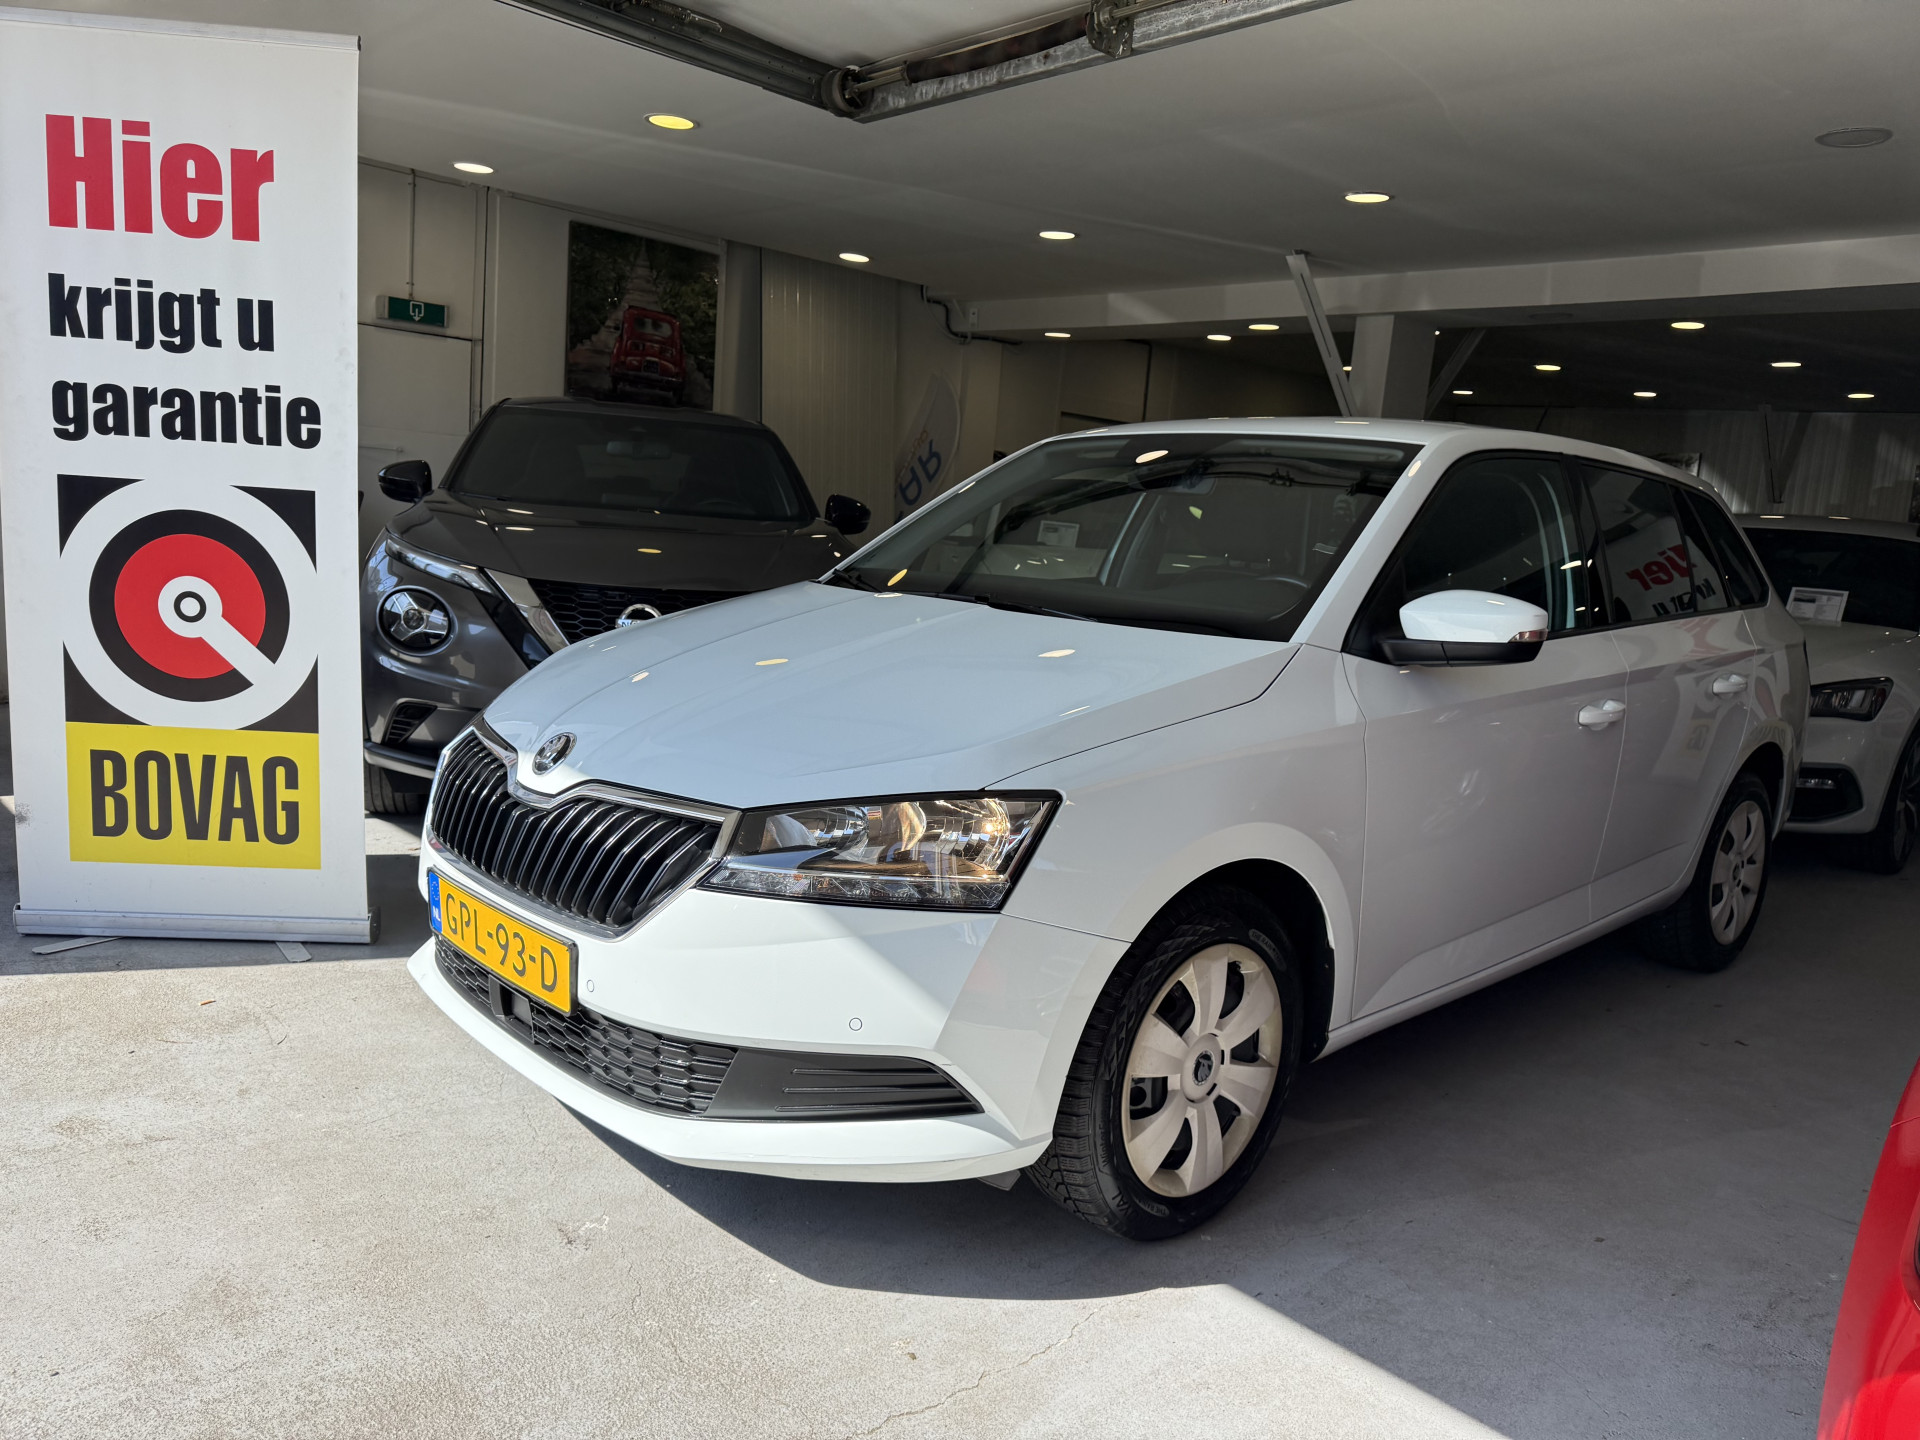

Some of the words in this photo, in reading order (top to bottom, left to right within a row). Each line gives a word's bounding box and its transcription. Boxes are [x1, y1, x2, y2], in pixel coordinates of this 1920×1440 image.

[45, 113, 275, 242] Hier
[47, 272, 222, 354] krijgt
[236, 298, 275, 352] u
[51, 379, 322, 450] garantie
[89, 748, 300, 845] BOVAG
[433, 905, 441, 922] NL
[445, 892, 558, 993] GPL-93-D
